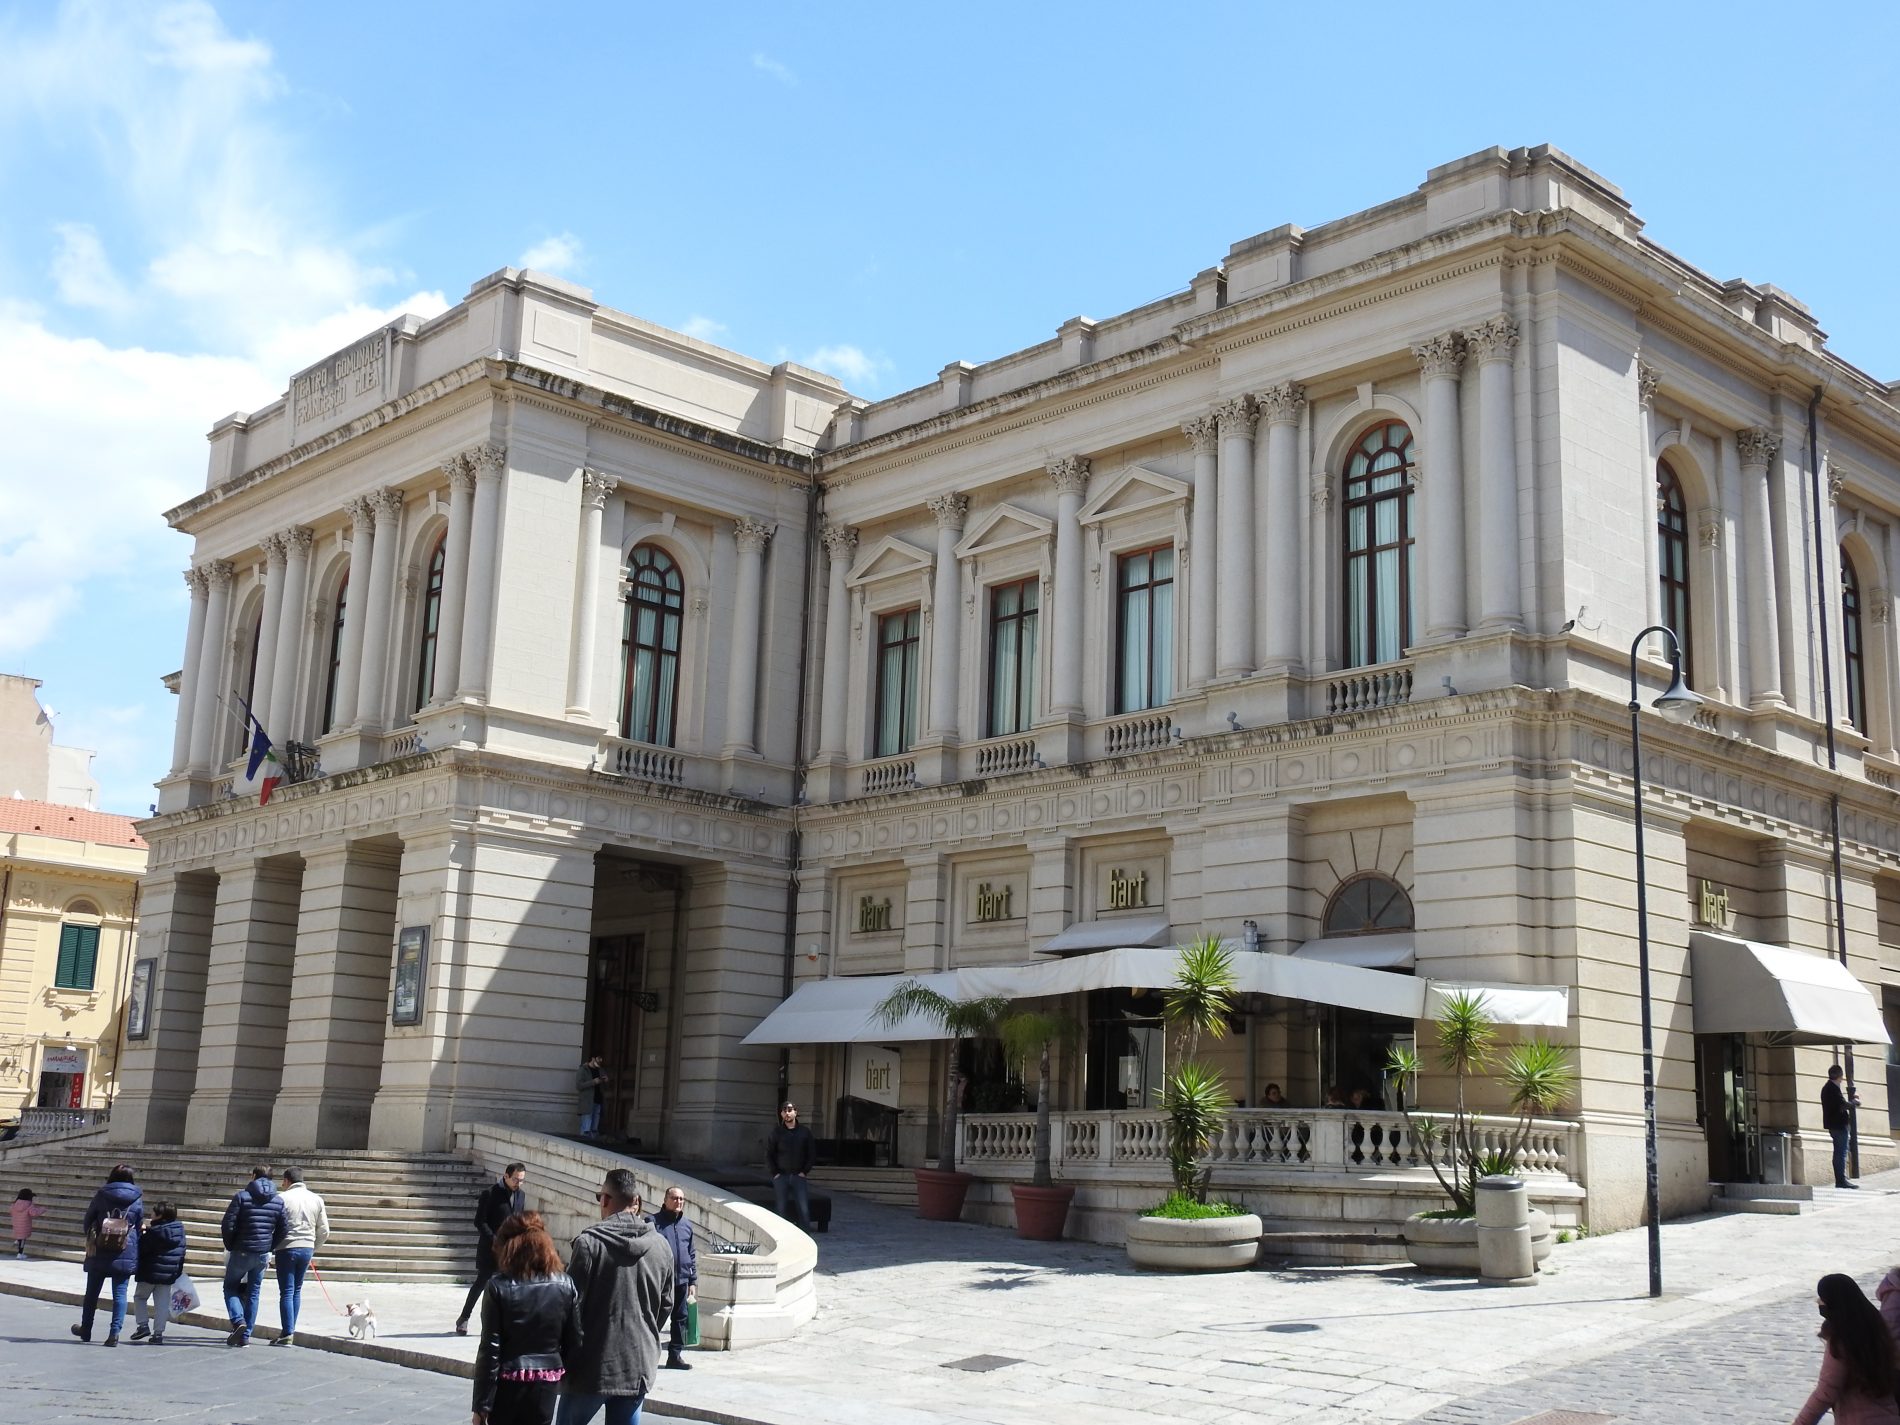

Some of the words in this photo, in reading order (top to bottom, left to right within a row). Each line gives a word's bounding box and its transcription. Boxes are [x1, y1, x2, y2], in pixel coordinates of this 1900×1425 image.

[295, 367, 327, 401] TEATRO
[335, 339, 384, 381] COMUNALE
[296, 383, 346, 426] FRANCESCO
[355, 361, 380, 397] CILEA
